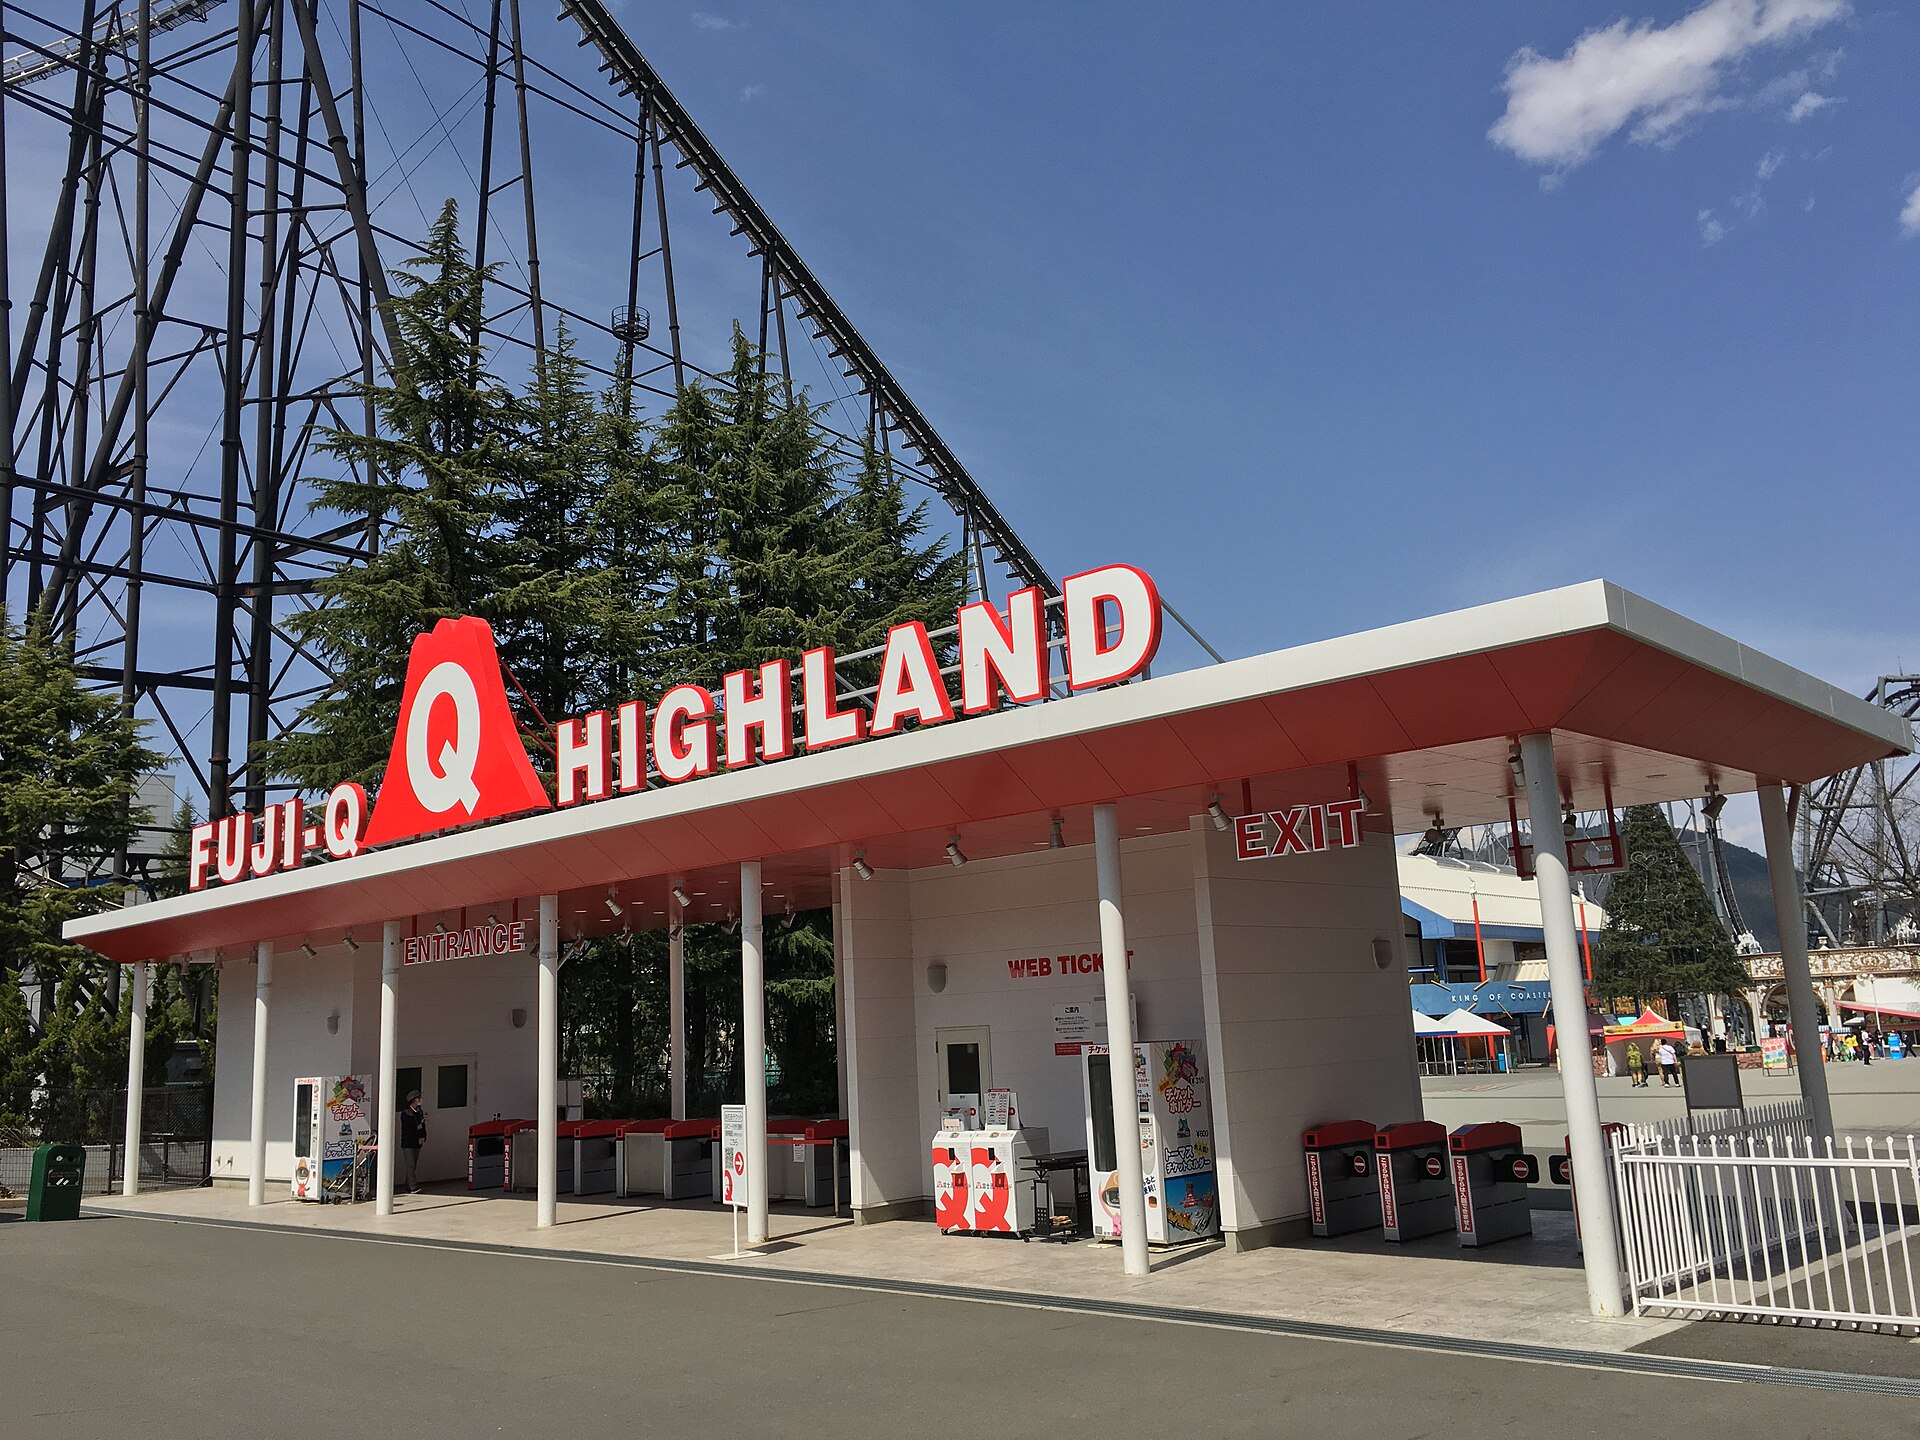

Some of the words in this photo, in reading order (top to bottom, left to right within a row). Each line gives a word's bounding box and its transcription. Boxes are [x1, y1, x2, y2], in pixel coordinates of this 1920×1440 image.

[189, 782, 367, 891] FUJI-Q
[406, 661, 481, 816] Q
[556, 563, 1162, 807] HIGHLAND
[1234, 799, 1365, 861] EXIT
[403, 921, 526, 966] ENTRANCE
[1008, 958, 1052, 979] WEB
[1057, 950, 1134, 975] TICKT
[1451, 994, 1479, 1002] KING
[1489, 993, 1502, 1002] OF
[1165, 1086, 1194, 1102] チケット
[331, 1102, 360, 1114] チケット
[1169, 1098, 1201, 1115] ホルダー
[333, 1110, 366, 1121] ホルダー
[325, 1140, 354, 1151] トーマス
[1165, 1145, 1194, 1162] トーマス
[1166, 1158, 1211, 1174] チケットホルダー
